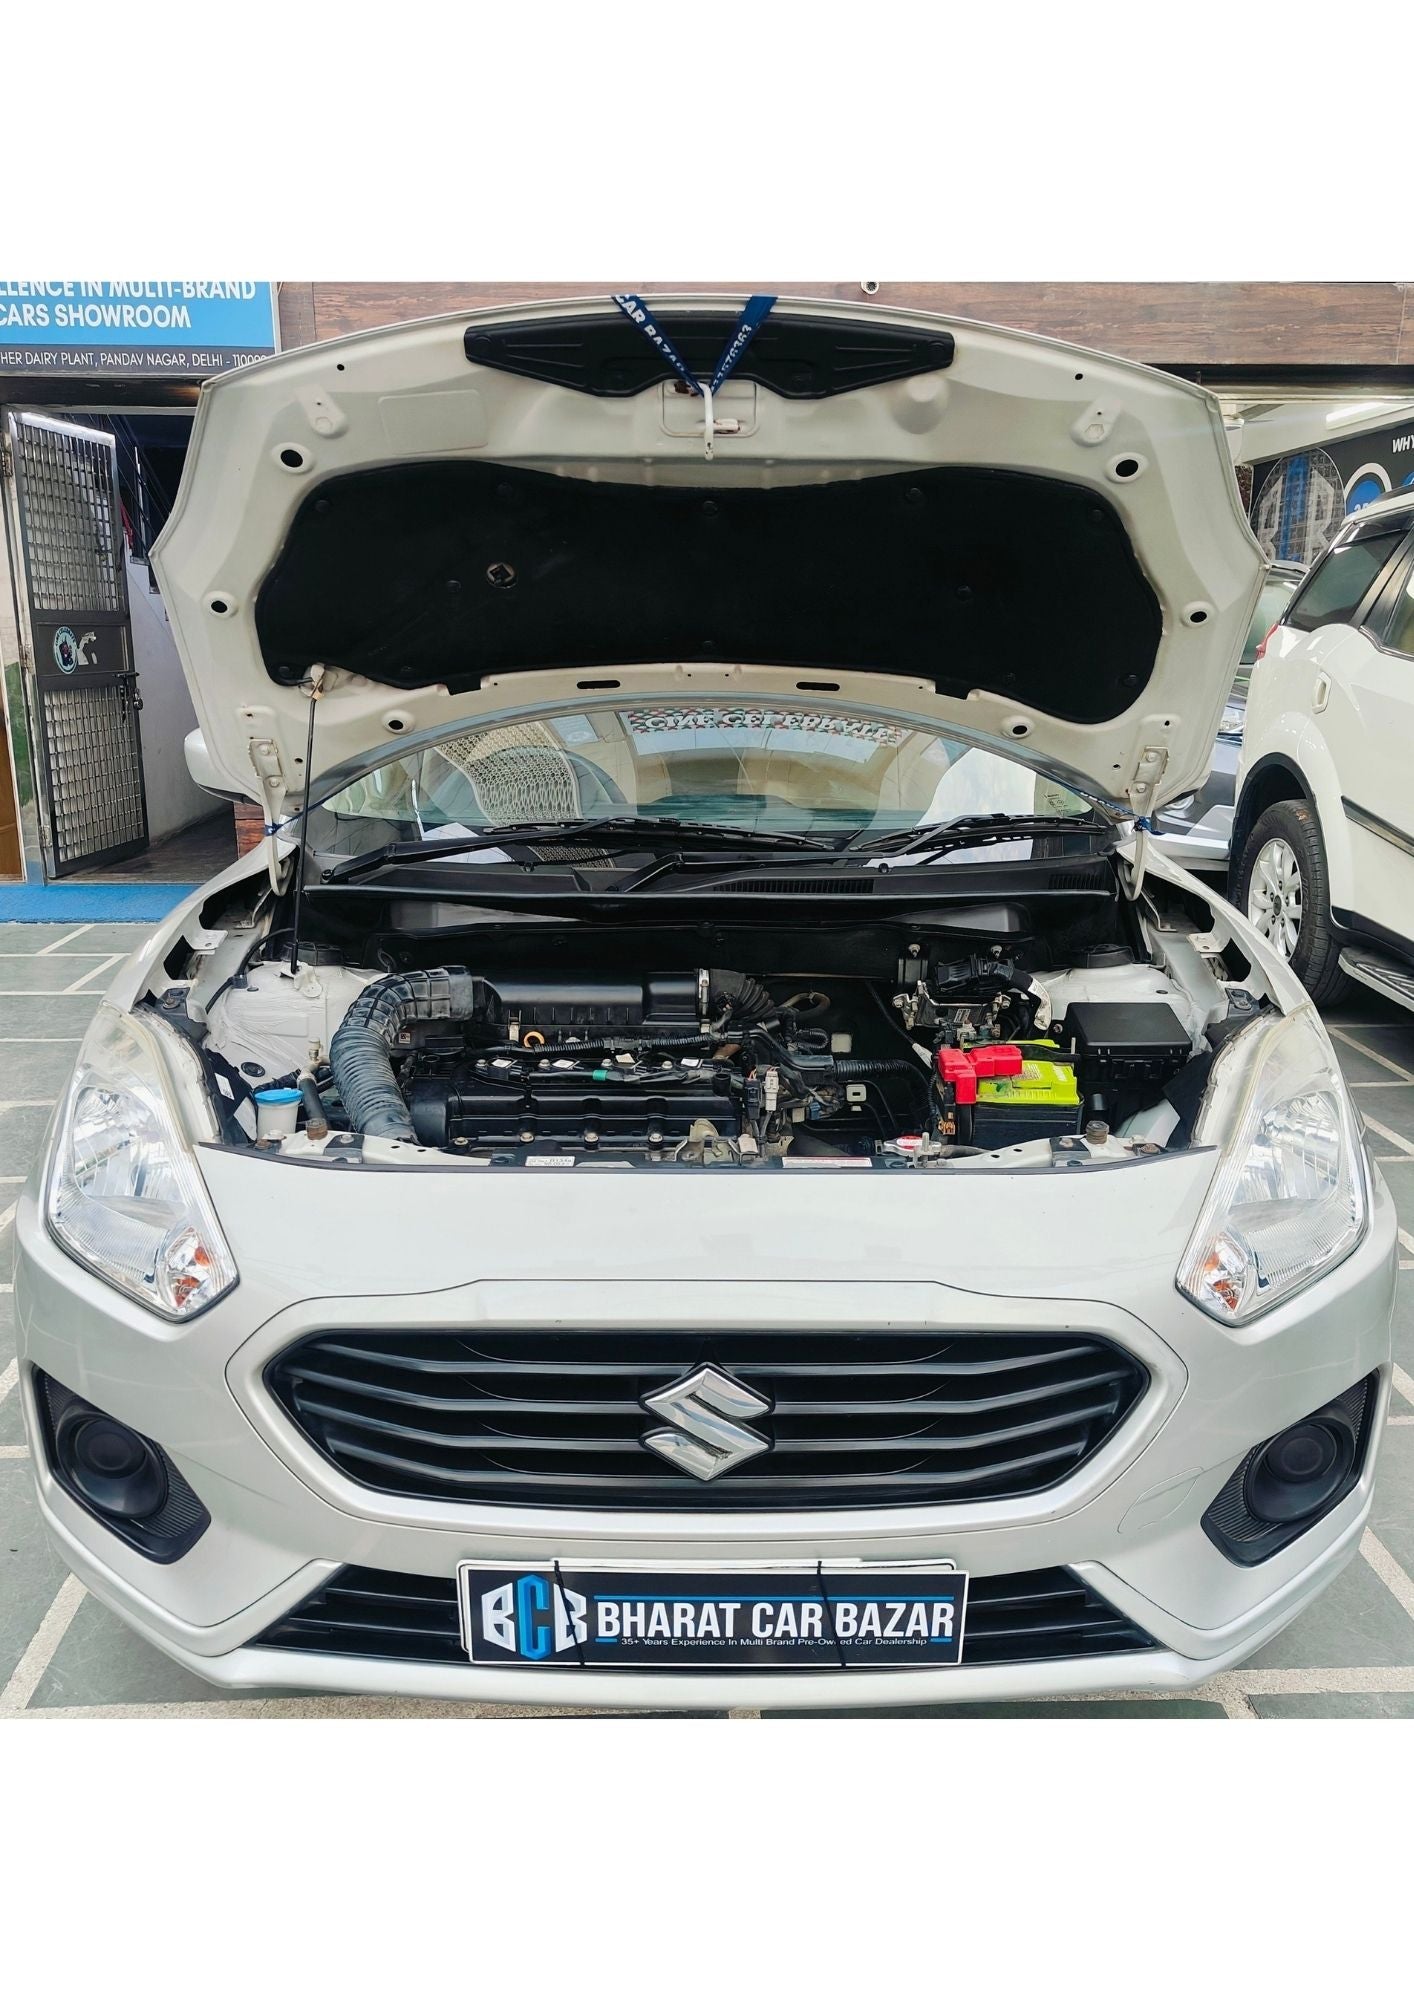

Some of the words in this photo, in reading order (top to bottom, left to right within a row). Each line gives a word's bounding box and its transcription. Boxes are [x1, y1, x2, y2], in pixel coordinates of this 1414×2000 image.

[80, 281, 104, 297] IN
[55, 303, 192, 328] SHOWROOM
[25, 352, 58, 366] DAIRY
[61, 352, 98, 368] PLANT,
[100, 353, 144, 367] PANDAV
[146, 353, 190, 369] NAGAR,
[192, 353, 223, 367] DELHI
[232, 354, 267, 367] 1100
[597, 1602, 741, 1638] BHARAT
[751, 1602, 823, 1638] CAR
[835, 1602, 954, 1638] BAZAR
[621, 1638, 640, 1646] 35+
[642, 1638, 669, 1646] Years
[671, 1638, 726, 1647] Experience
[728, 1638, 738, 1646] In
[740, 1638, 764, 1646] Multi
[765, 1638, 796, 1646] Brand
[798, 1638, 853, 1646] Pre-Owed
[854, 1638, 873, 1646] Car
[874, 1637, 927, 1646] Dealership
